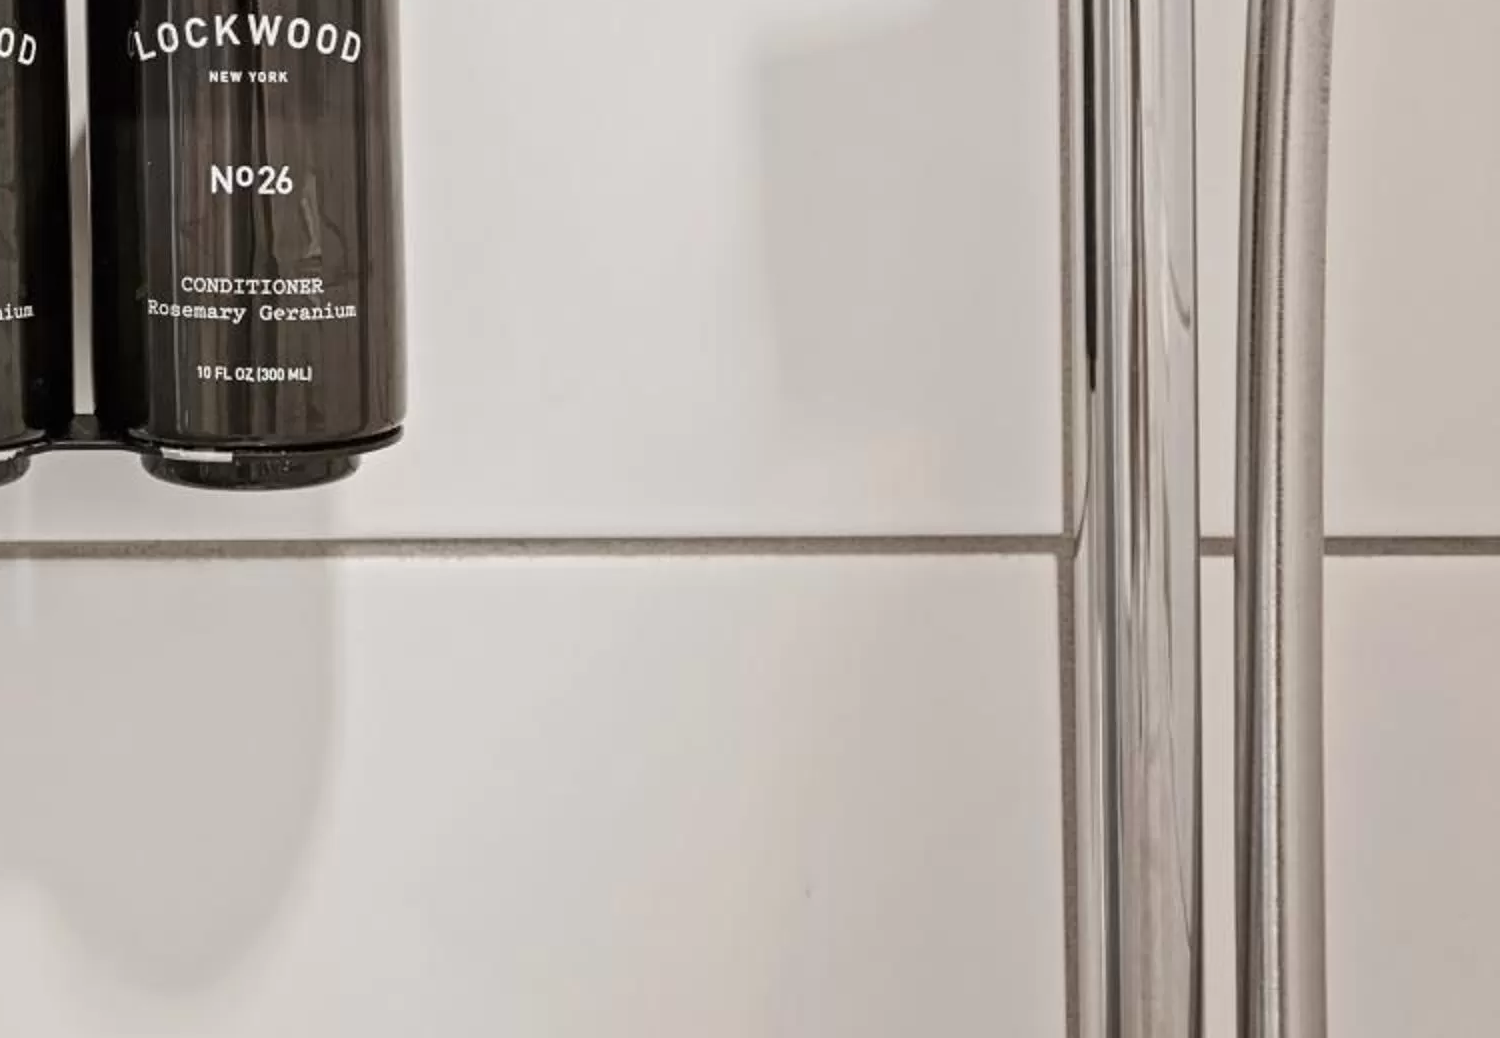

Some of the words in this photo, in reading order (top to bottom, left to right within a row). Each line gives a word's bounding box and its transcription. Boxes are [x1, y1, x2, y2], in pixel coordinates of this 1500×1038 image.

[134, 14, 361, 62] LOCKWOOD
[209, 72, 242, 83] NEW
[248, 72, 288, 83] YORK
[181, 278, 324, 294] CONDITIONER
[148, 299, 246, 323] Rosemary
[259, 304, 356, 321] Geranium
[197, 366, 211, 379] 10
[215, 367, 232, 381] FL
[235, 367, 254, 382] OZ
